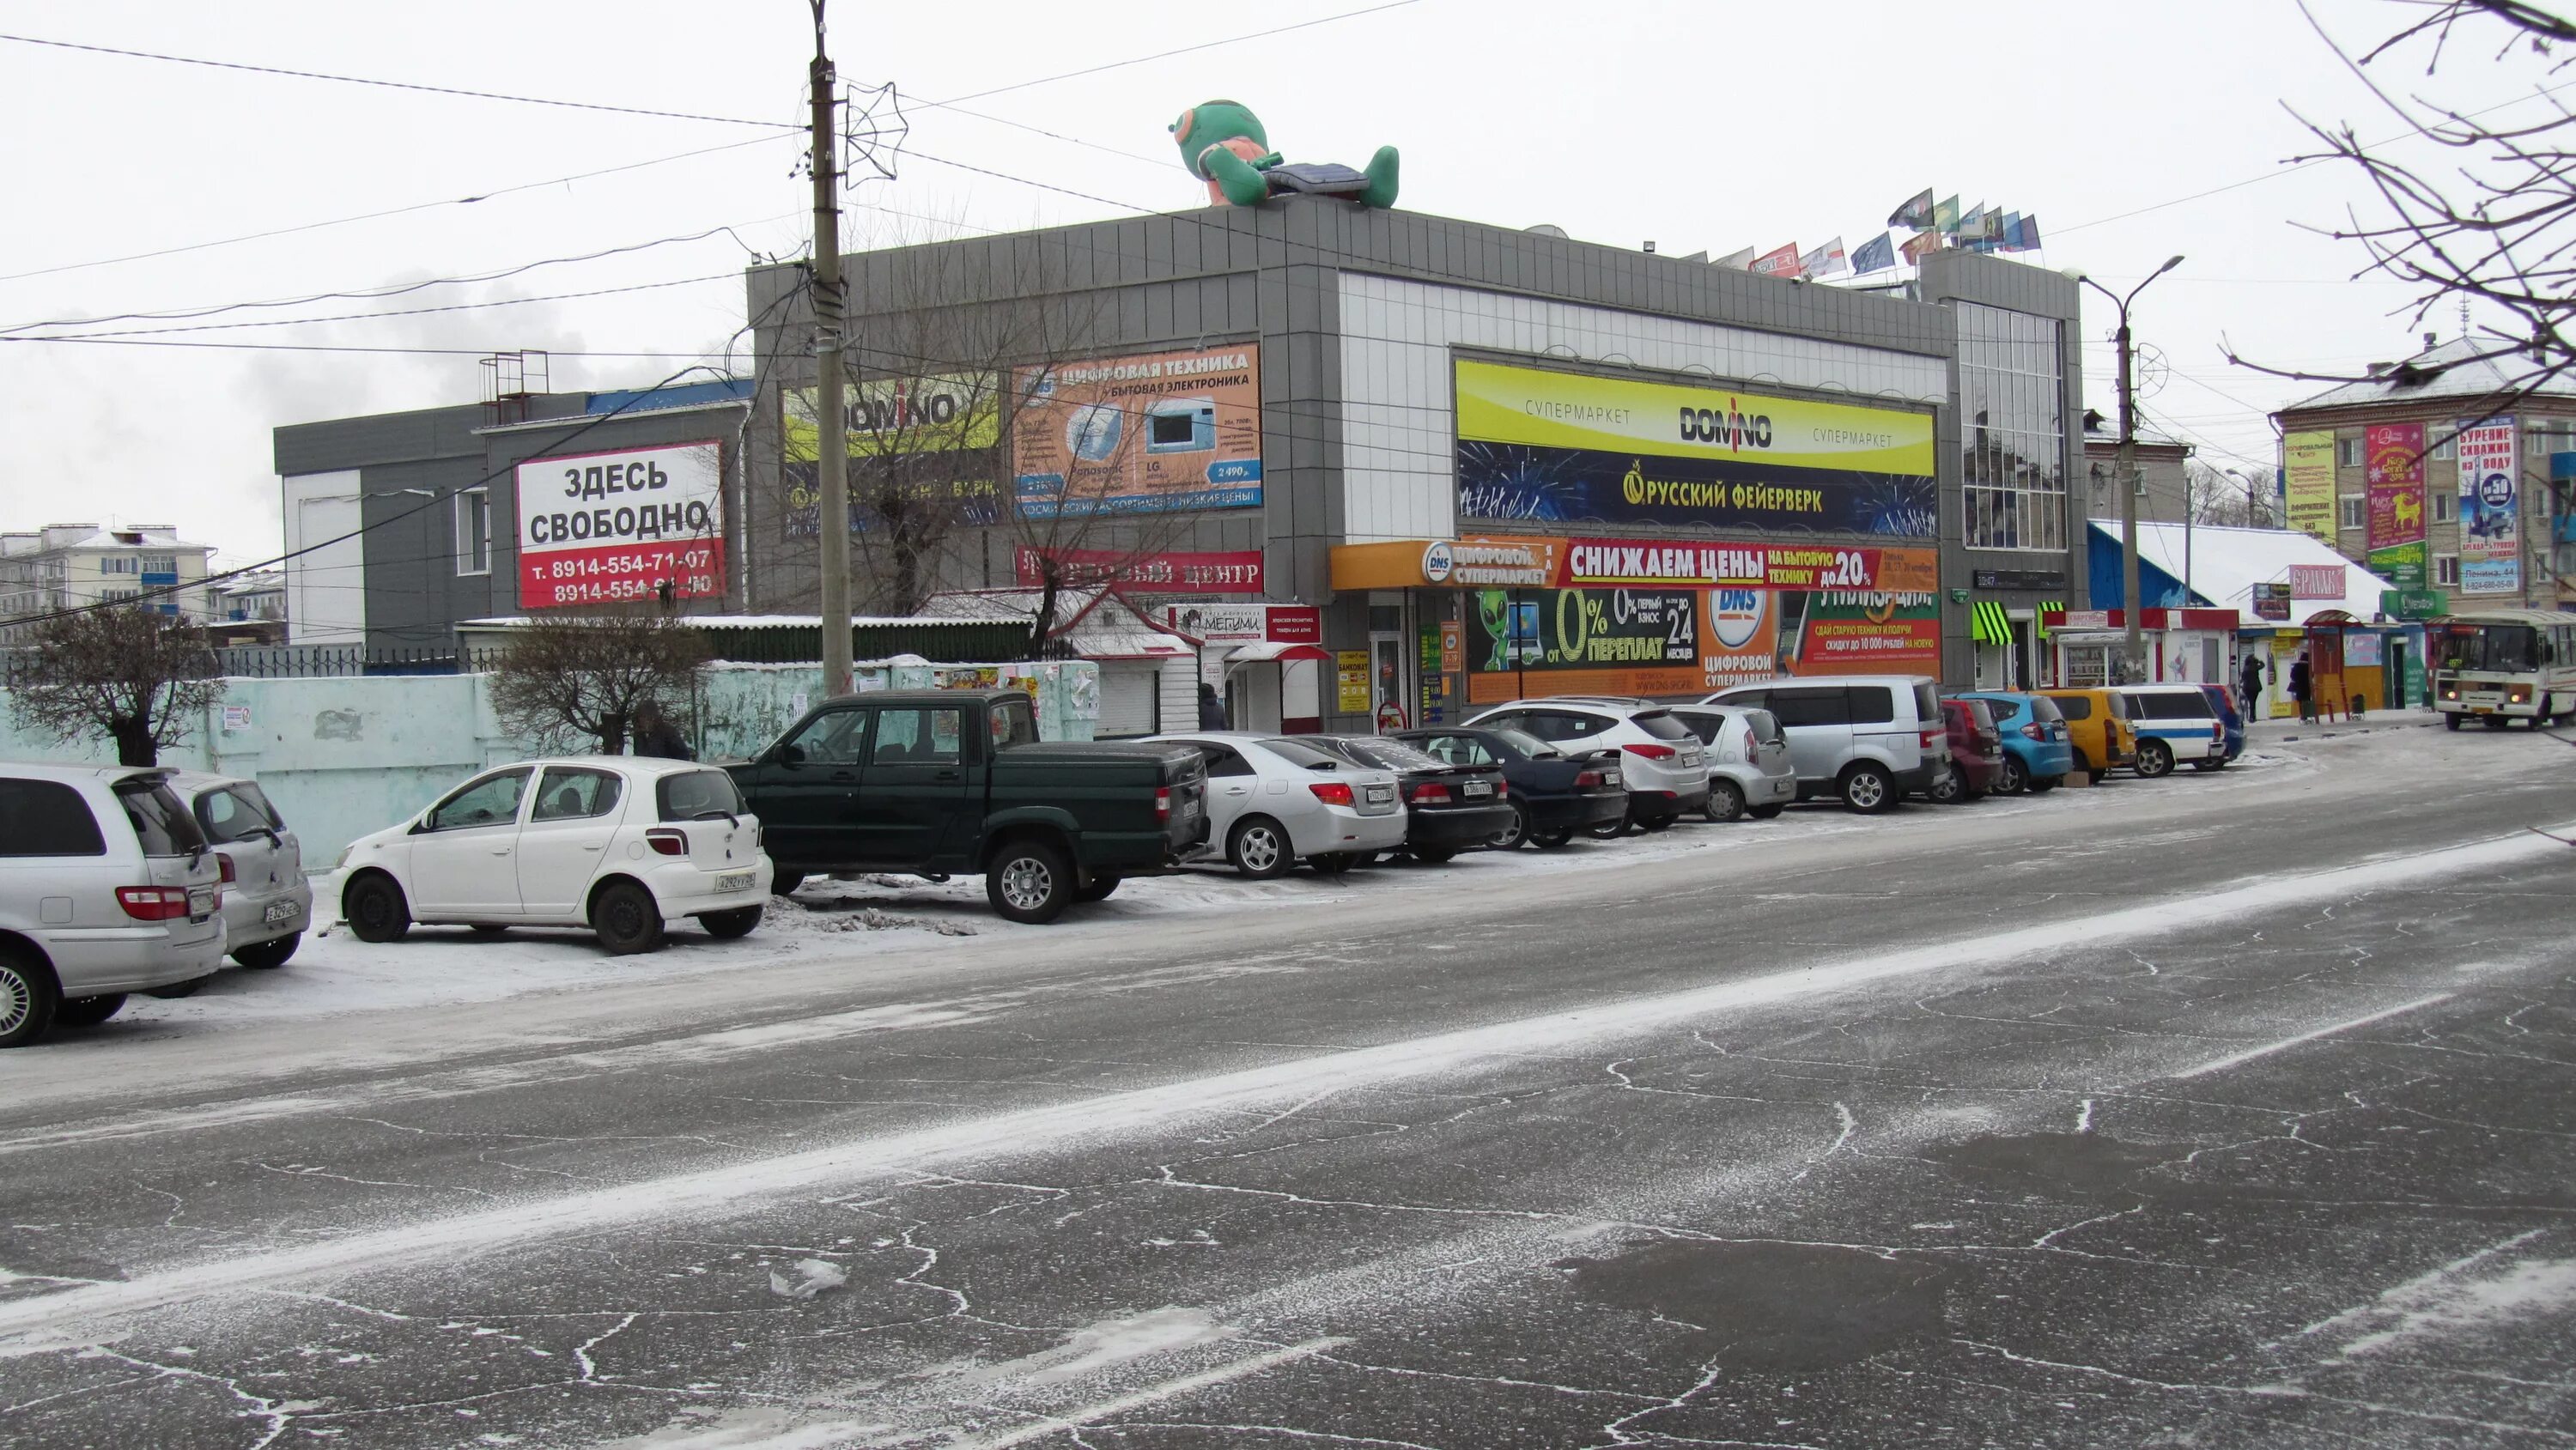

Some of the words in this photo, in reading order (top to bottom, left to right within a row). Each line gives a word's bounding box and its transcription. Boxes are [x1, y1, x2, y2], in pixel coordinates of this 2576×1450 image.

[1062, 363, 1161, 385] ЦИФРОВАЯ
[1165, 353, 1249, 377] ТЕХНИКА
[1111, 382, 1164, 397] БЫТОВАЯ
[1167, 374, 1249, 392] ЭЛЕКТРОНИКА
[1525, 398, 1631, 425] СУПЕРМАРКЕТ
[1813, 428, 1893, 448] СУПЕРМАРКЕТ
[2459, 428, 2509, 443] БУРЕНИЕ
[2460, 442, 2511, 457] СКВАЖИН
[1072, 464, 1124, 476] Panasonic
[1146, 462, 1160, 472] LG
[2462, 461, 2473, 470] на
[2483, 457, 2511, 470] ВОДУ
[564, 461, 668, 502] ЗДЕСЬ
[2493, 478, 2508, 495] 50
[1647, 479, 1727, 508] РУССКИЙ
[1732, 482, 1823, 513] ФЕЙЕРВЕРК
[531, 501, 708, 543] СВОБОДНО
[532, 567, 546, 579] т.
[552, 550, 710, 579] 8914-554-71-07
[1430, 556, 1449, 569] DNS
[1453, 545, 1535, 566] ЦИФРОВОЙ
[1571, 544, 1696, 578] СНИЖАЕМ
[1700, 549, 1765, 583] ЦЕНЫ
[1768, 549, 1783, 566] НА
[1783, 549, 1833, 567] БЫТОВУЮ
[1183, 564, 1259, 589] ЦЕНТР
[1453, 567, 1546, 585] СУПЕРМАРКЕТ
[1768, 569, 1814, 585] ТЕХНИКУ
[1637, 596, 1662, 610] ПЕРВЫЙ
[1719, 590, 1757, 611] DNS
[1637, 612, 1660, 623] ВЗНОС
[1667, 607, 1693, 644] 24
[1814, 623, 1832, 636] СДАЙ
[1833, 625, 1856, 635] СТАРУЮ
[1856, 625, 1882, 635] ТЕХНИКУ
[1883, 625, 1887, 634] И
[1888, 625, 1911, 634] ПОЛУЧИ
[1826, 640, 1850, 651] СКИДКУ
[1850, 640, 1860, 651] ДО
[1861, 638, 1868, 649] 10
[1869, 637, 1882, 650] 000
[1883, 637, 1905, 649] РУБЛЕЙ
[1905, 640, 1913, 648] НА
[1914, 639, 1934, 648] НОВУЮ
[1667, 647, 1693, 661] МЕСЯЦЕВ
[1704, 652, 1771, 674] ЦИФРОВОЙ
[1339, 663, 1369, 672] БАНКОМАТ
[1704, 672, 1772, 688] СУПЕРМАРКЕТ
